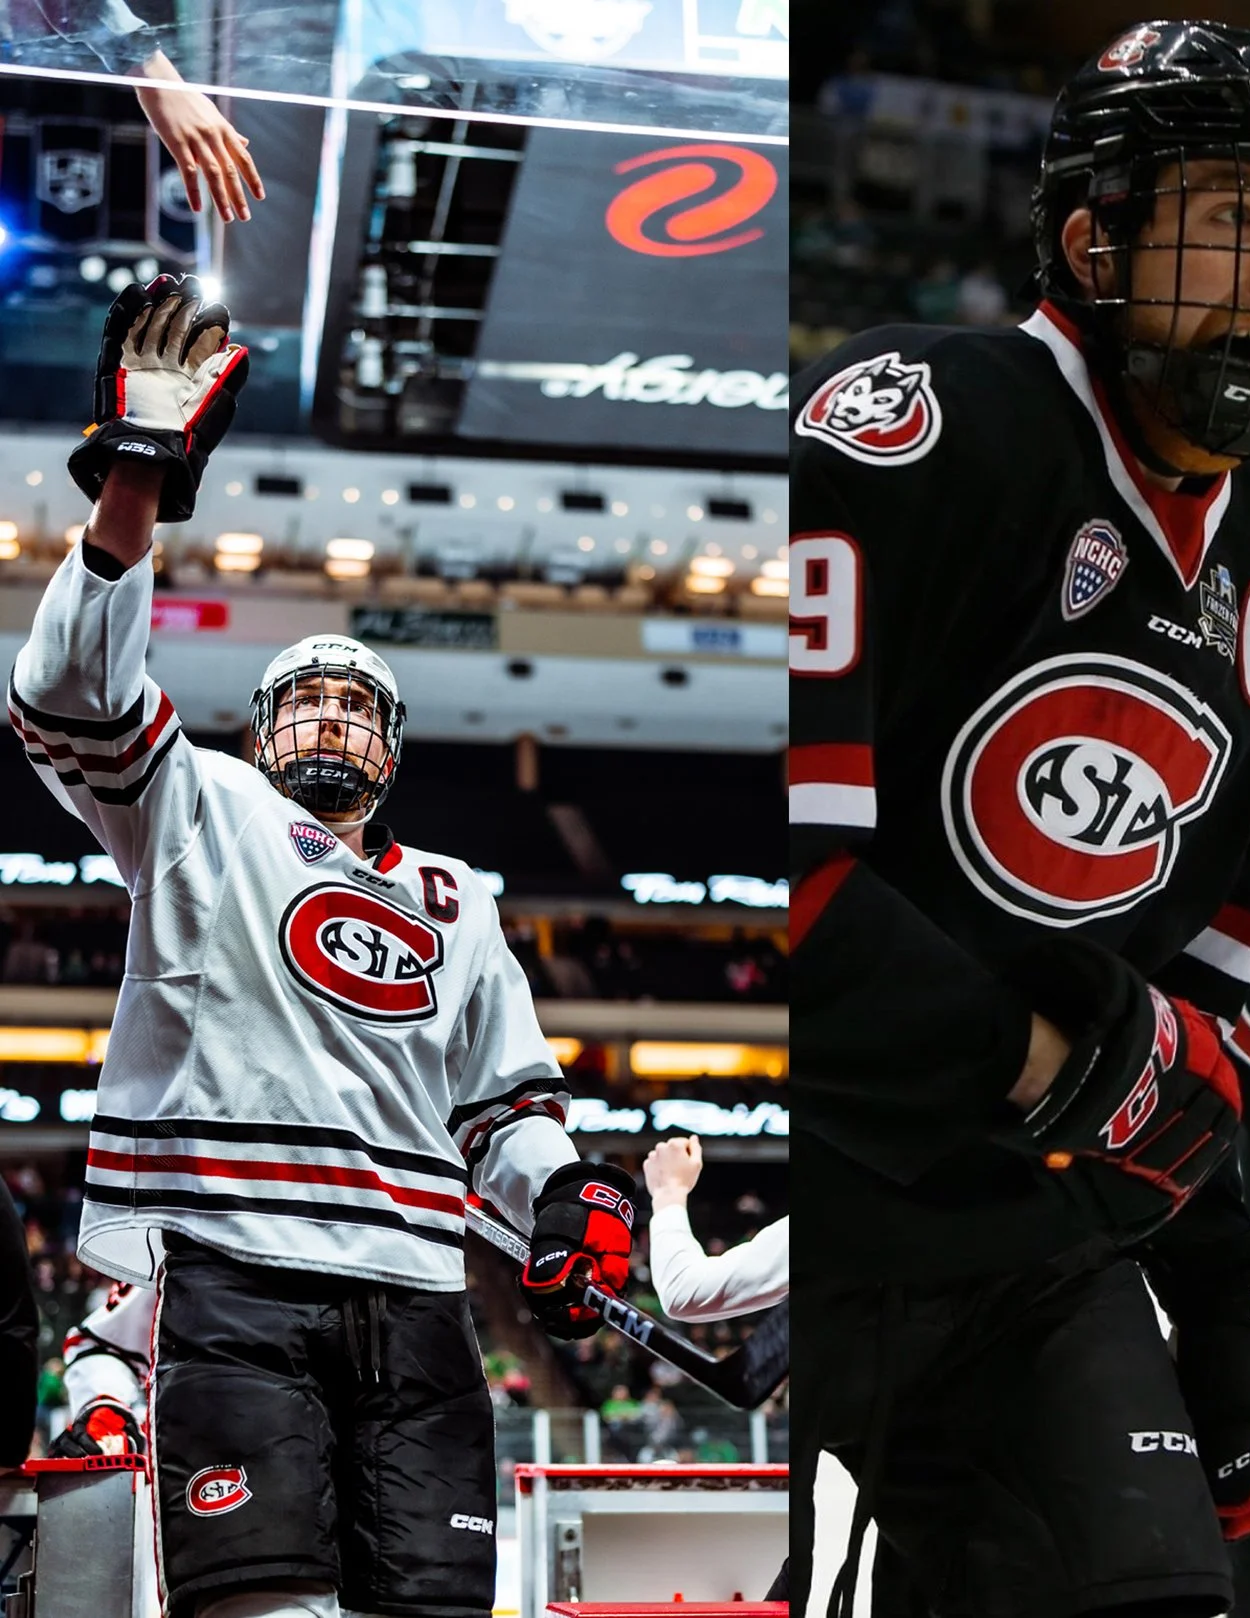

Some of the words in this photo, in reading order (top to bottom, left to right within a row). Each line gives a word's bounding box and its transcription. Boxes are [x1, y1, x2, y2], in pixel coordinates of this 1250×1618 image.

[116, 444, 157, 456] CCM
[1074, 537, 1122, 580] NCHC
[789, 529, 863, 679] 9
[1147, 614, 1203, 649] CCM
[312, 643, 359, 653] CCM
[305, 767, 349, 780] CCM
[291, 824, 336, 849] NCHC
[352, 868, 395, 889] CCM
[418, 866, 459, 924] C
[477, 1220, 526, 1262] JETSPEED
[535, 1250, 568, 1267] CCM
[583, 1285, 654, 1346] CCM
[1128, 1431, 1199, 1458] CCM
[450, 1513, 494, 1535] CCM
